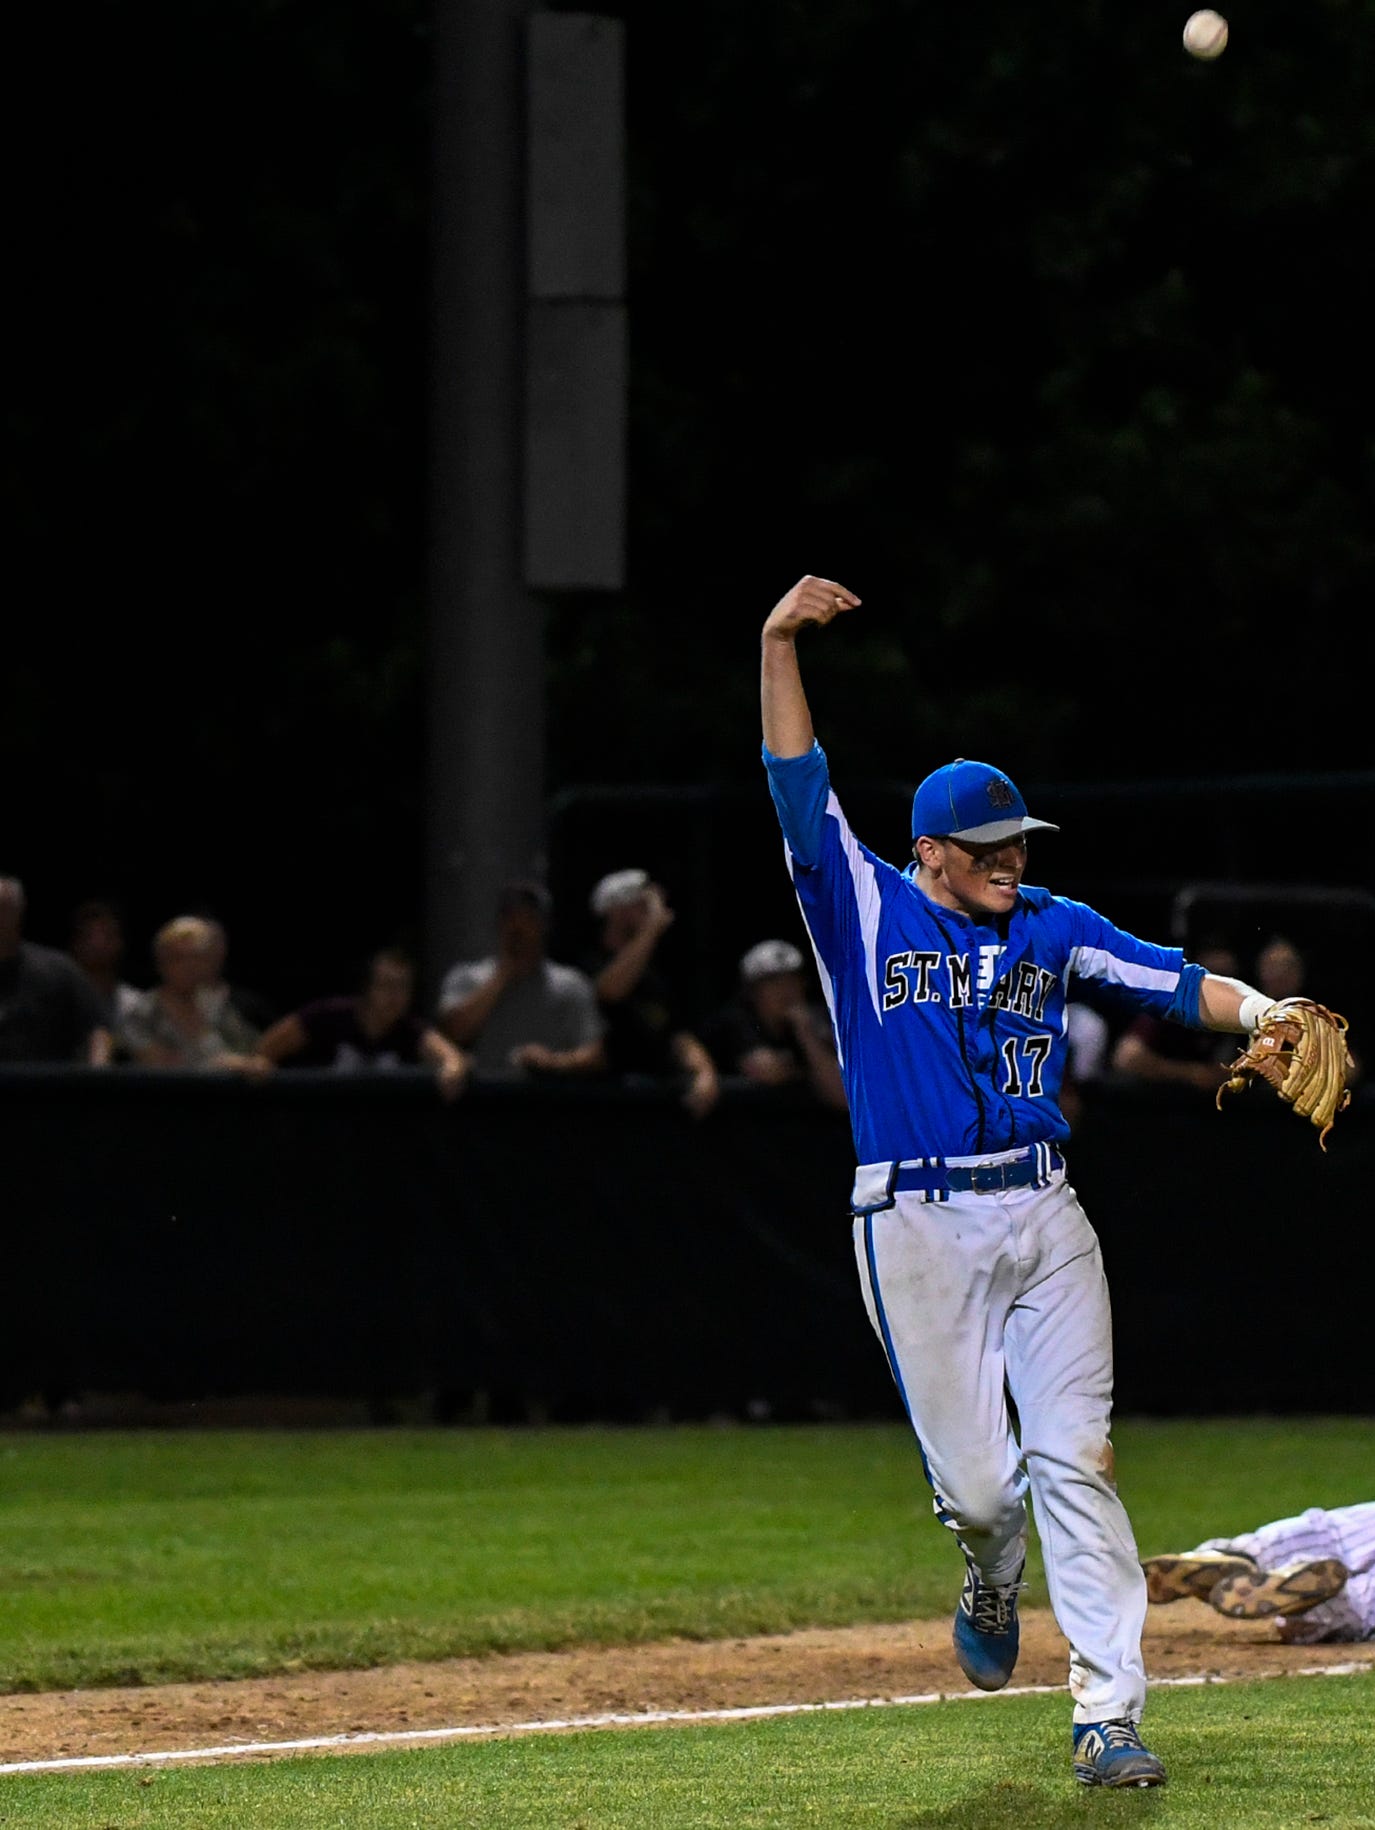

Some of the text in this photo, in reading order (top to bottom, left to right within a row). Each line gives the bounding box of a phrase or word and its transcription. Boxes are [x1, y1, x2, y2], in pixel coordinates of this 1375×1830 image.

[883, 950, 941, 1011] ST.
[946, 953, 1058, 1022] MARY
[1002, 1034, 1053, 1098] 17
